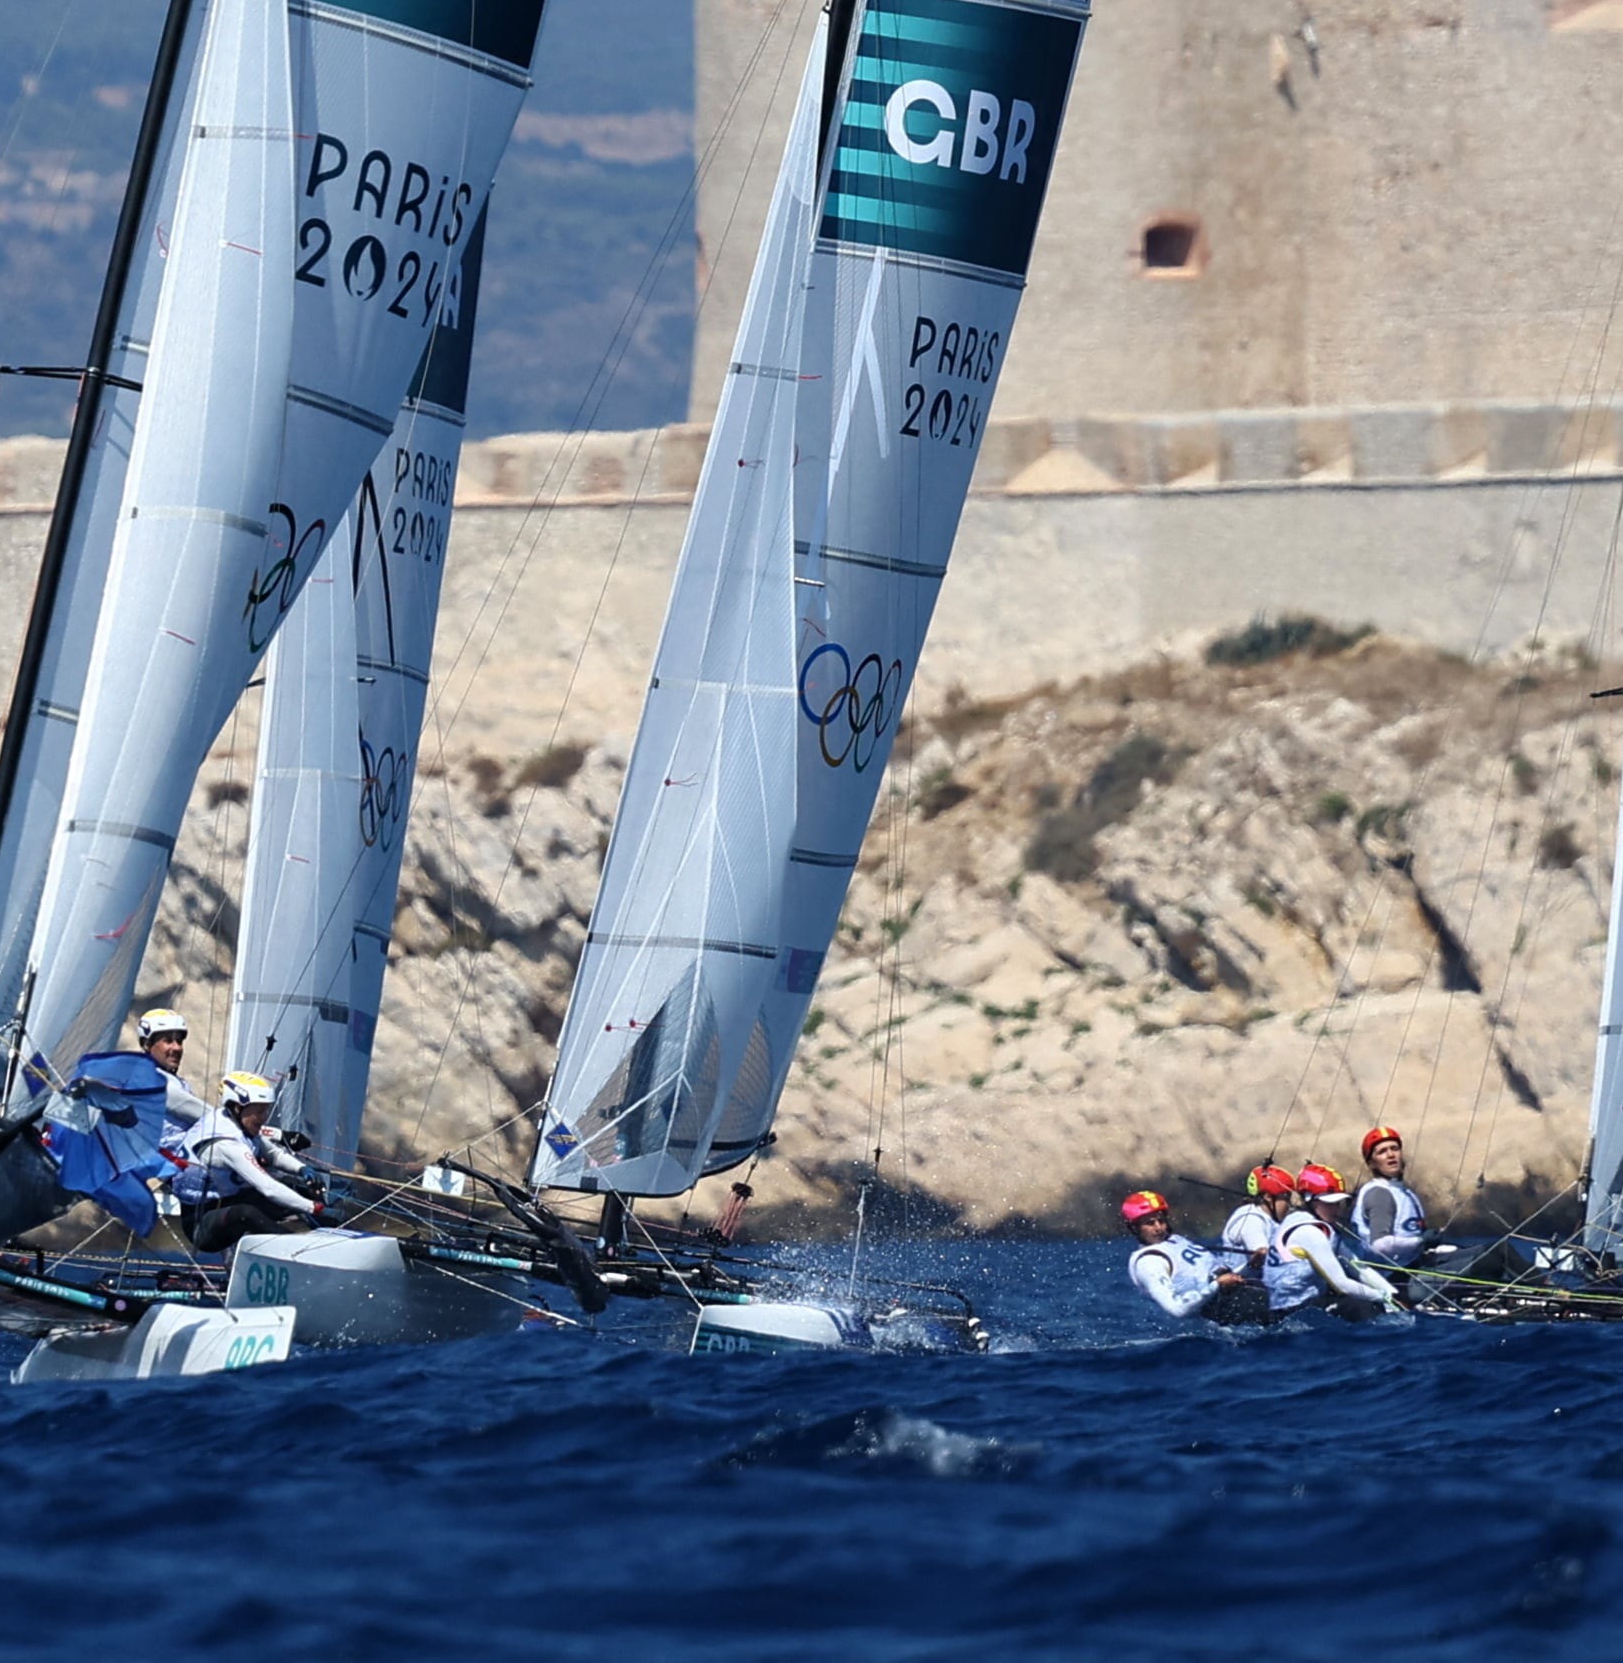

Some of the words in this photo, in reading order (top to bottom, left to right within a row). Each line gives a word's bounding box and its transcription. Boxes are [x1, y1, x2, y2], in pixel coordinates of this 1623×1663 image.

[885, 79, 1035, 184] GBR
[295, 218, 441, 327] 2024
[899, 383, 979, 449] 2024
[393, 507, 442, 566] 2024
[246, 1262, 289, 1304] GBR
